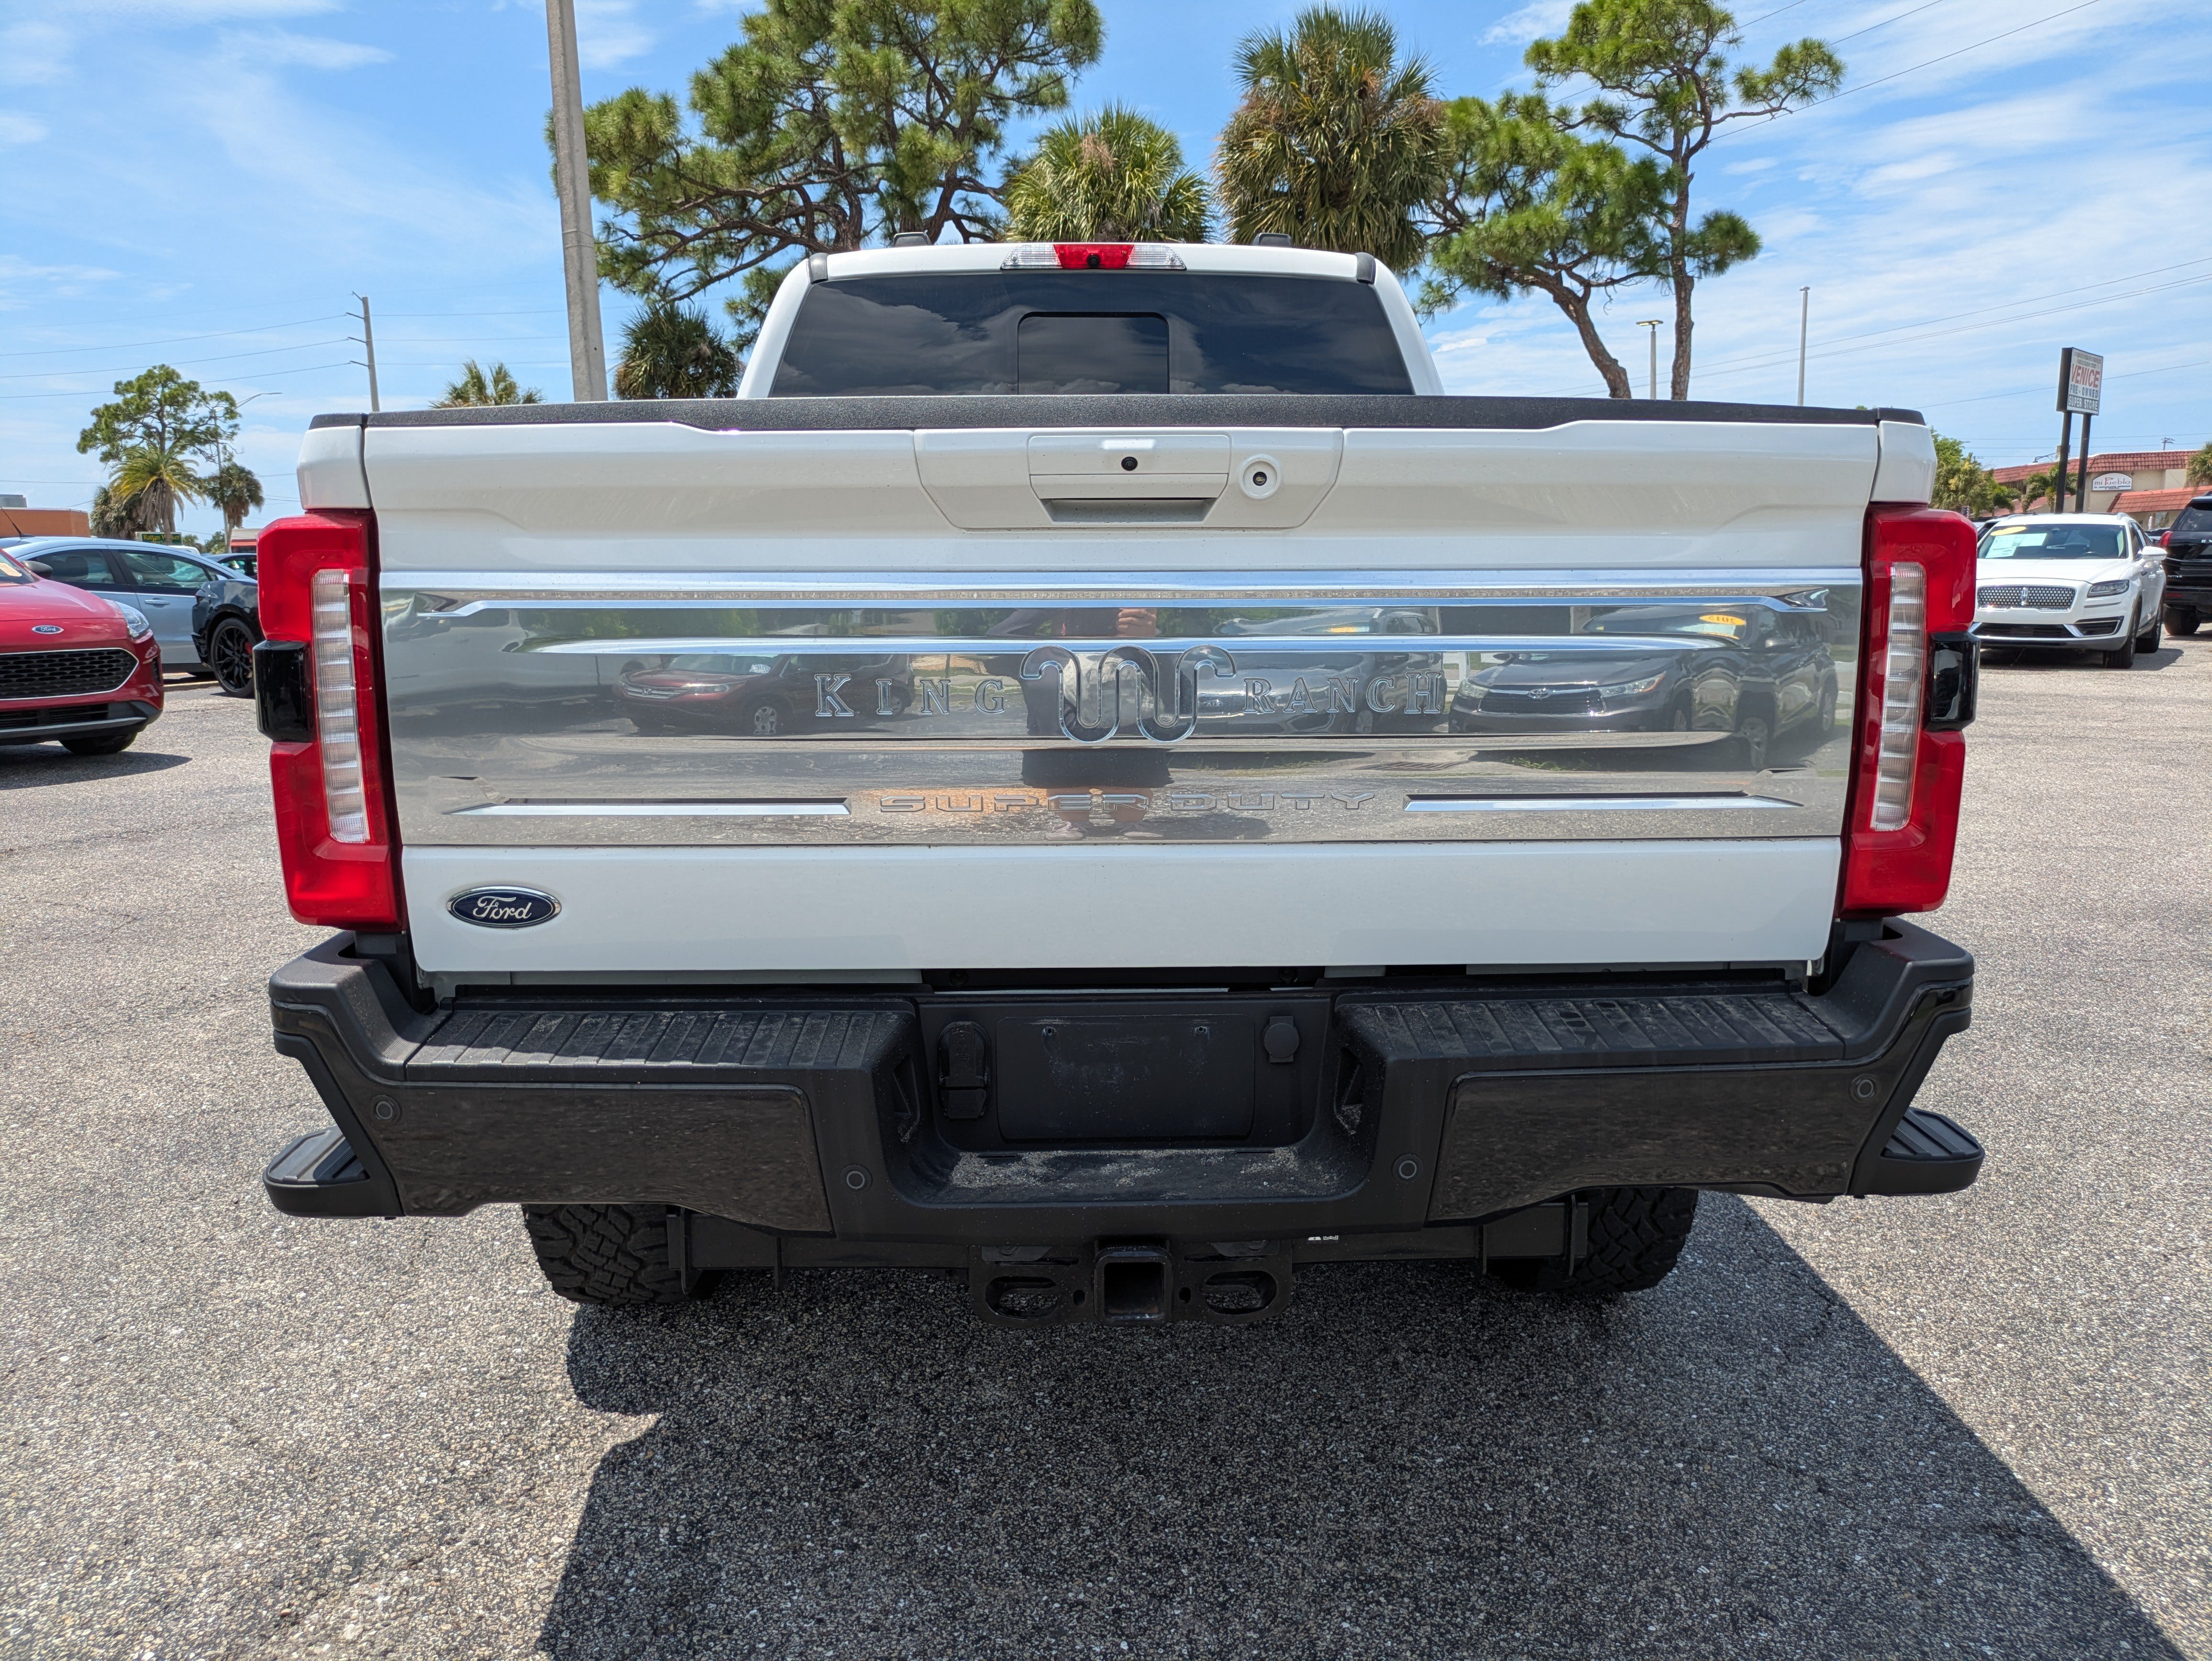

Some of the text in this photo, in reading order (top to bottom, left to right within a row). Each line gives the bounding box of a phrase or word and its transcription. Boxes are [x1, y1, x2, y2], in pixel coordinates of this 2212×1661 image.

[2071, 364, 2100, 388] VENICE
[2068, 396, 2098, 410] SUPER STORE
[2104, 477, 2131, 486] Pueblo
[814, 671, 1442, 717] KING RANCH
[880, 793, 1375, 812] SUPER DUTY
[473, 896, 532, 919] Ford
